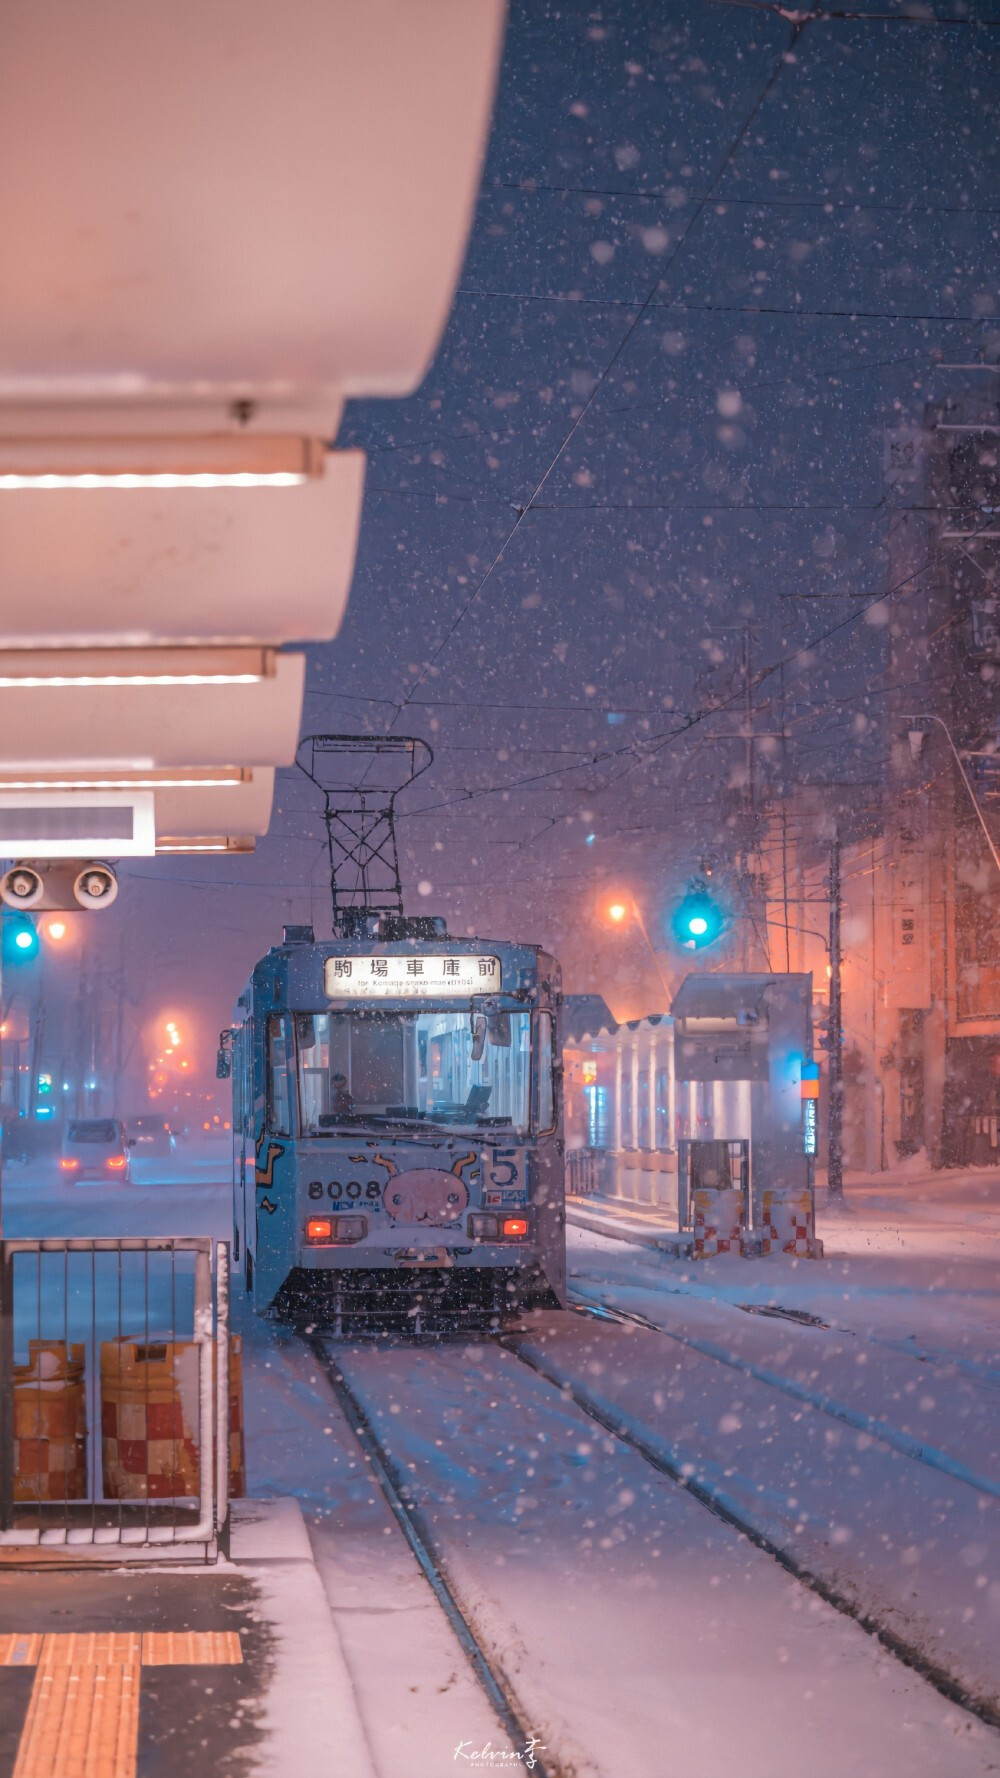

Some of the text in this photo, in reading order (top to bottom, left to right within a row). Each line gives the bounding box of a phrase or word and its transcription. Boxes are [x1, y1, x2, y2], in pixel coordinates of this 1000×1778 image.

[334, 959, 496, 978] 駒場車庫前
[490, 1149, 518, 1187] 5
[308, 1181, 381, 1200] 8008
